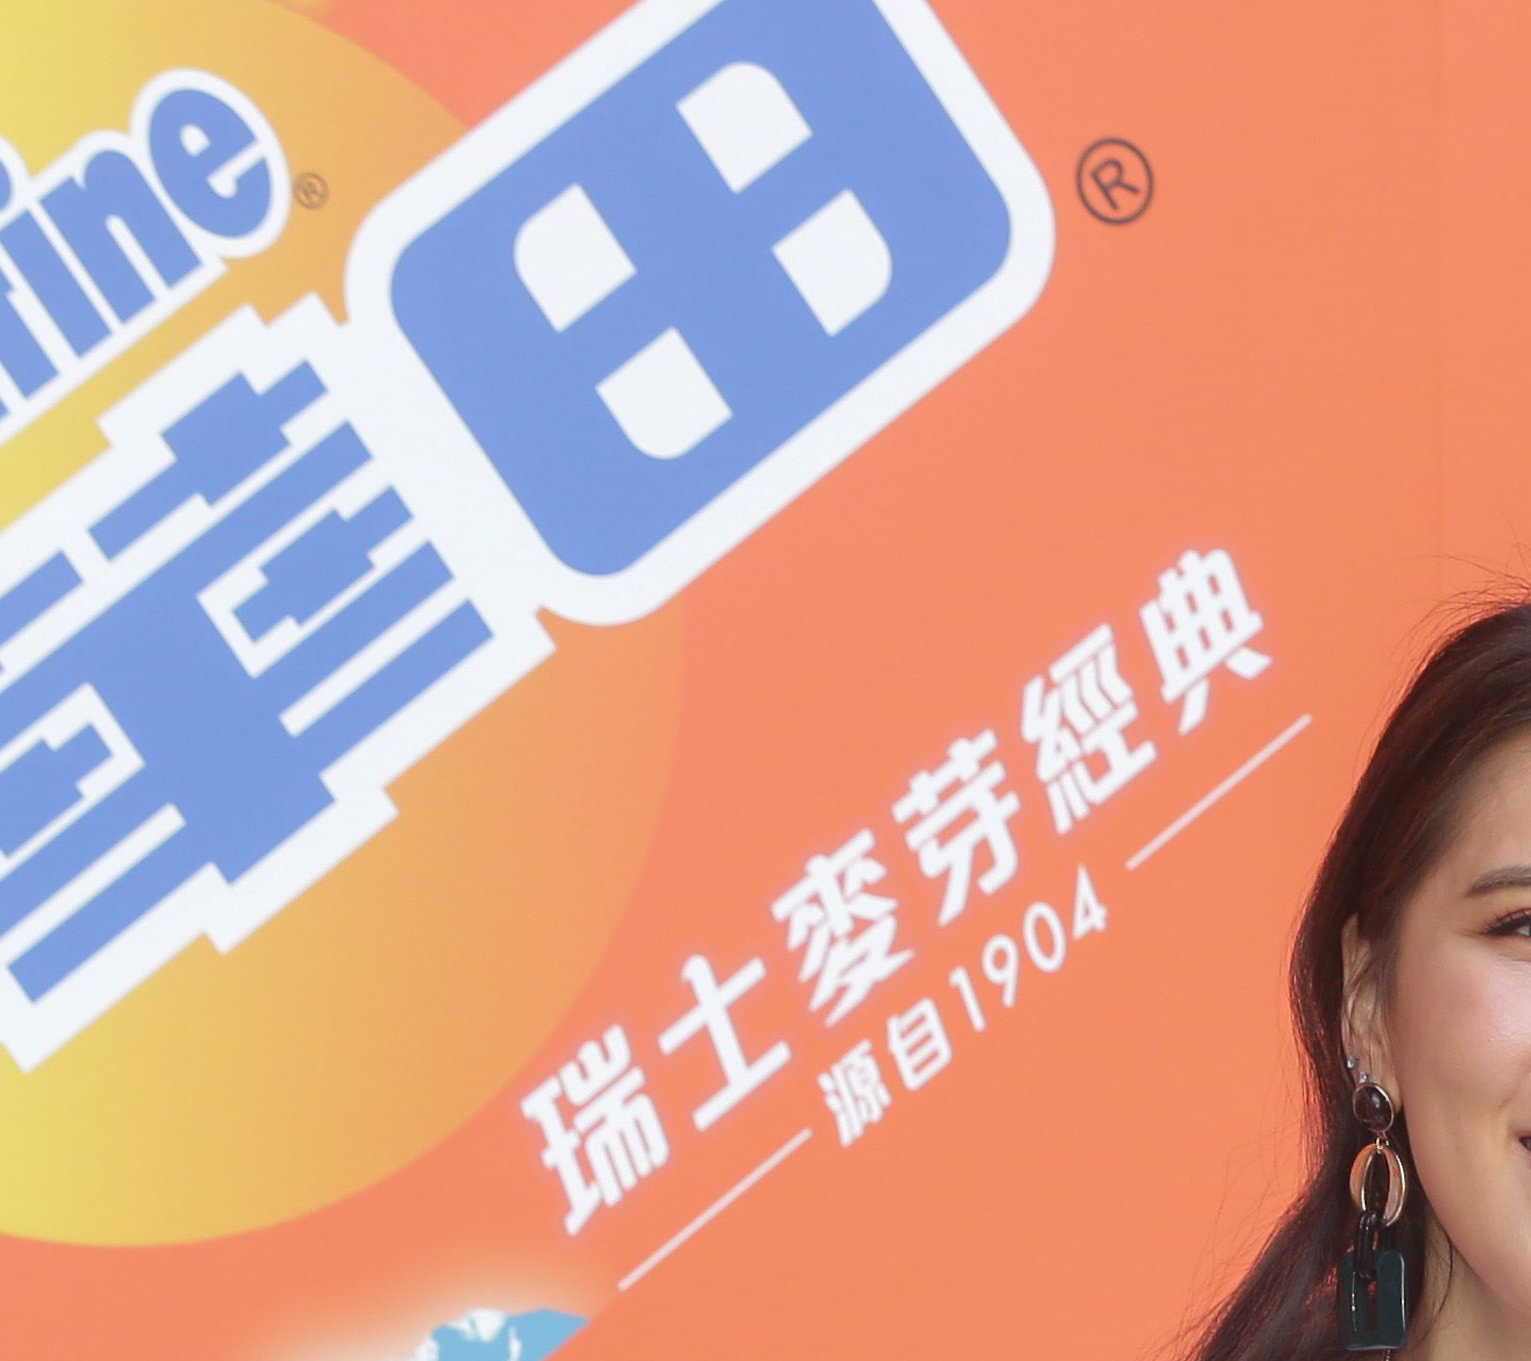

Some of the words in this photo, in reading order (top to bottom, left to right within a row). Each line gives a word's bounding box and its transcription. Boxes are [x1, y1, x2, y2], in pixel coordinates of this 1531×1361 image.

[520, 548, 1272, 1237] 瑞士麥芽經典
[819, 866, 1108, 1147] 源自1904
